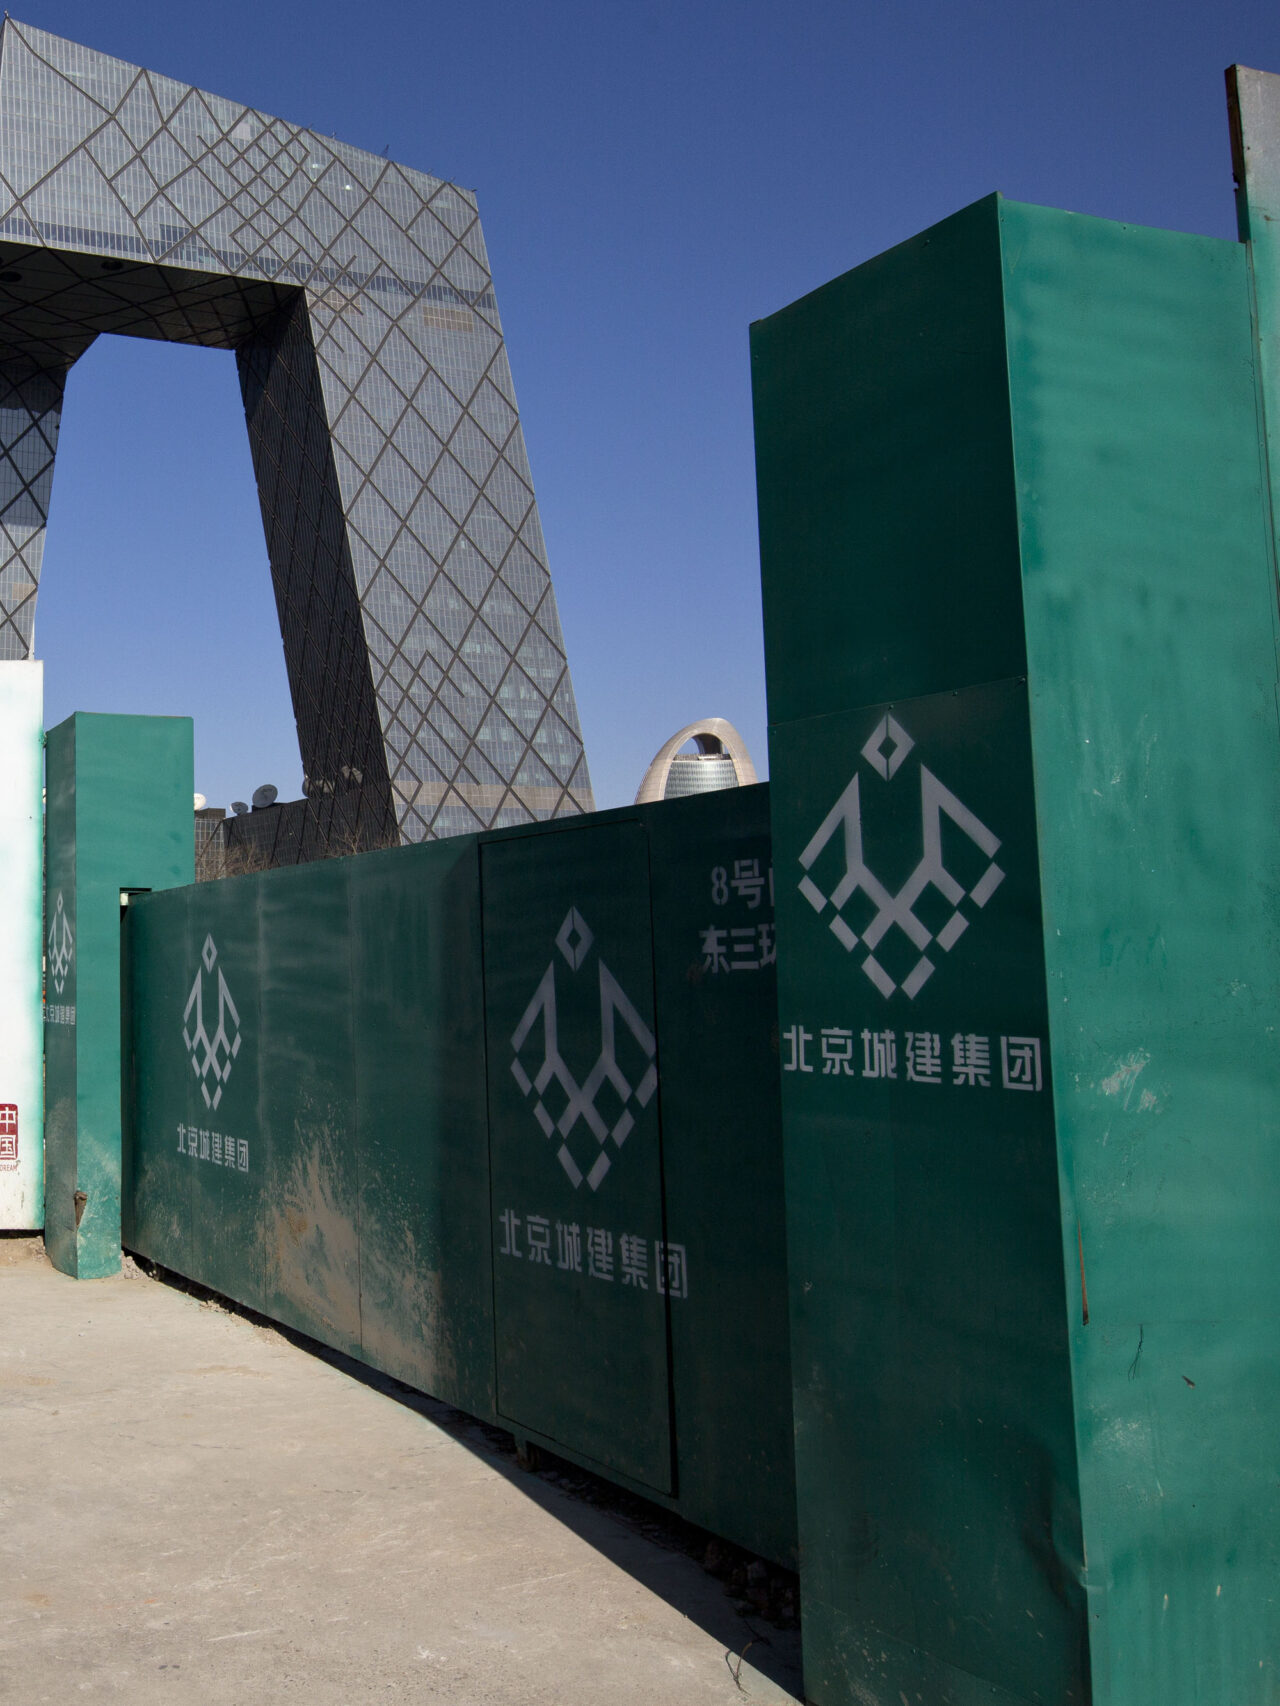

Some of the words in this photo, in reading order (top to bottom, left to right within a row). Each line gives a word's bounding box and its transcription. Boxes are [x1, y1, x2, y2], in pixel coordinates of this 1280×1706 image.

[711, 858, 775, 910] 8号
[782, 1025, 1043, 1092] 北京城建集团
[0, 1163, 18, 1172] DREAM
[176, 1122, 249, 1173] 北京城建集团
[498, 1208, 688, 1299] 北京城建集团
